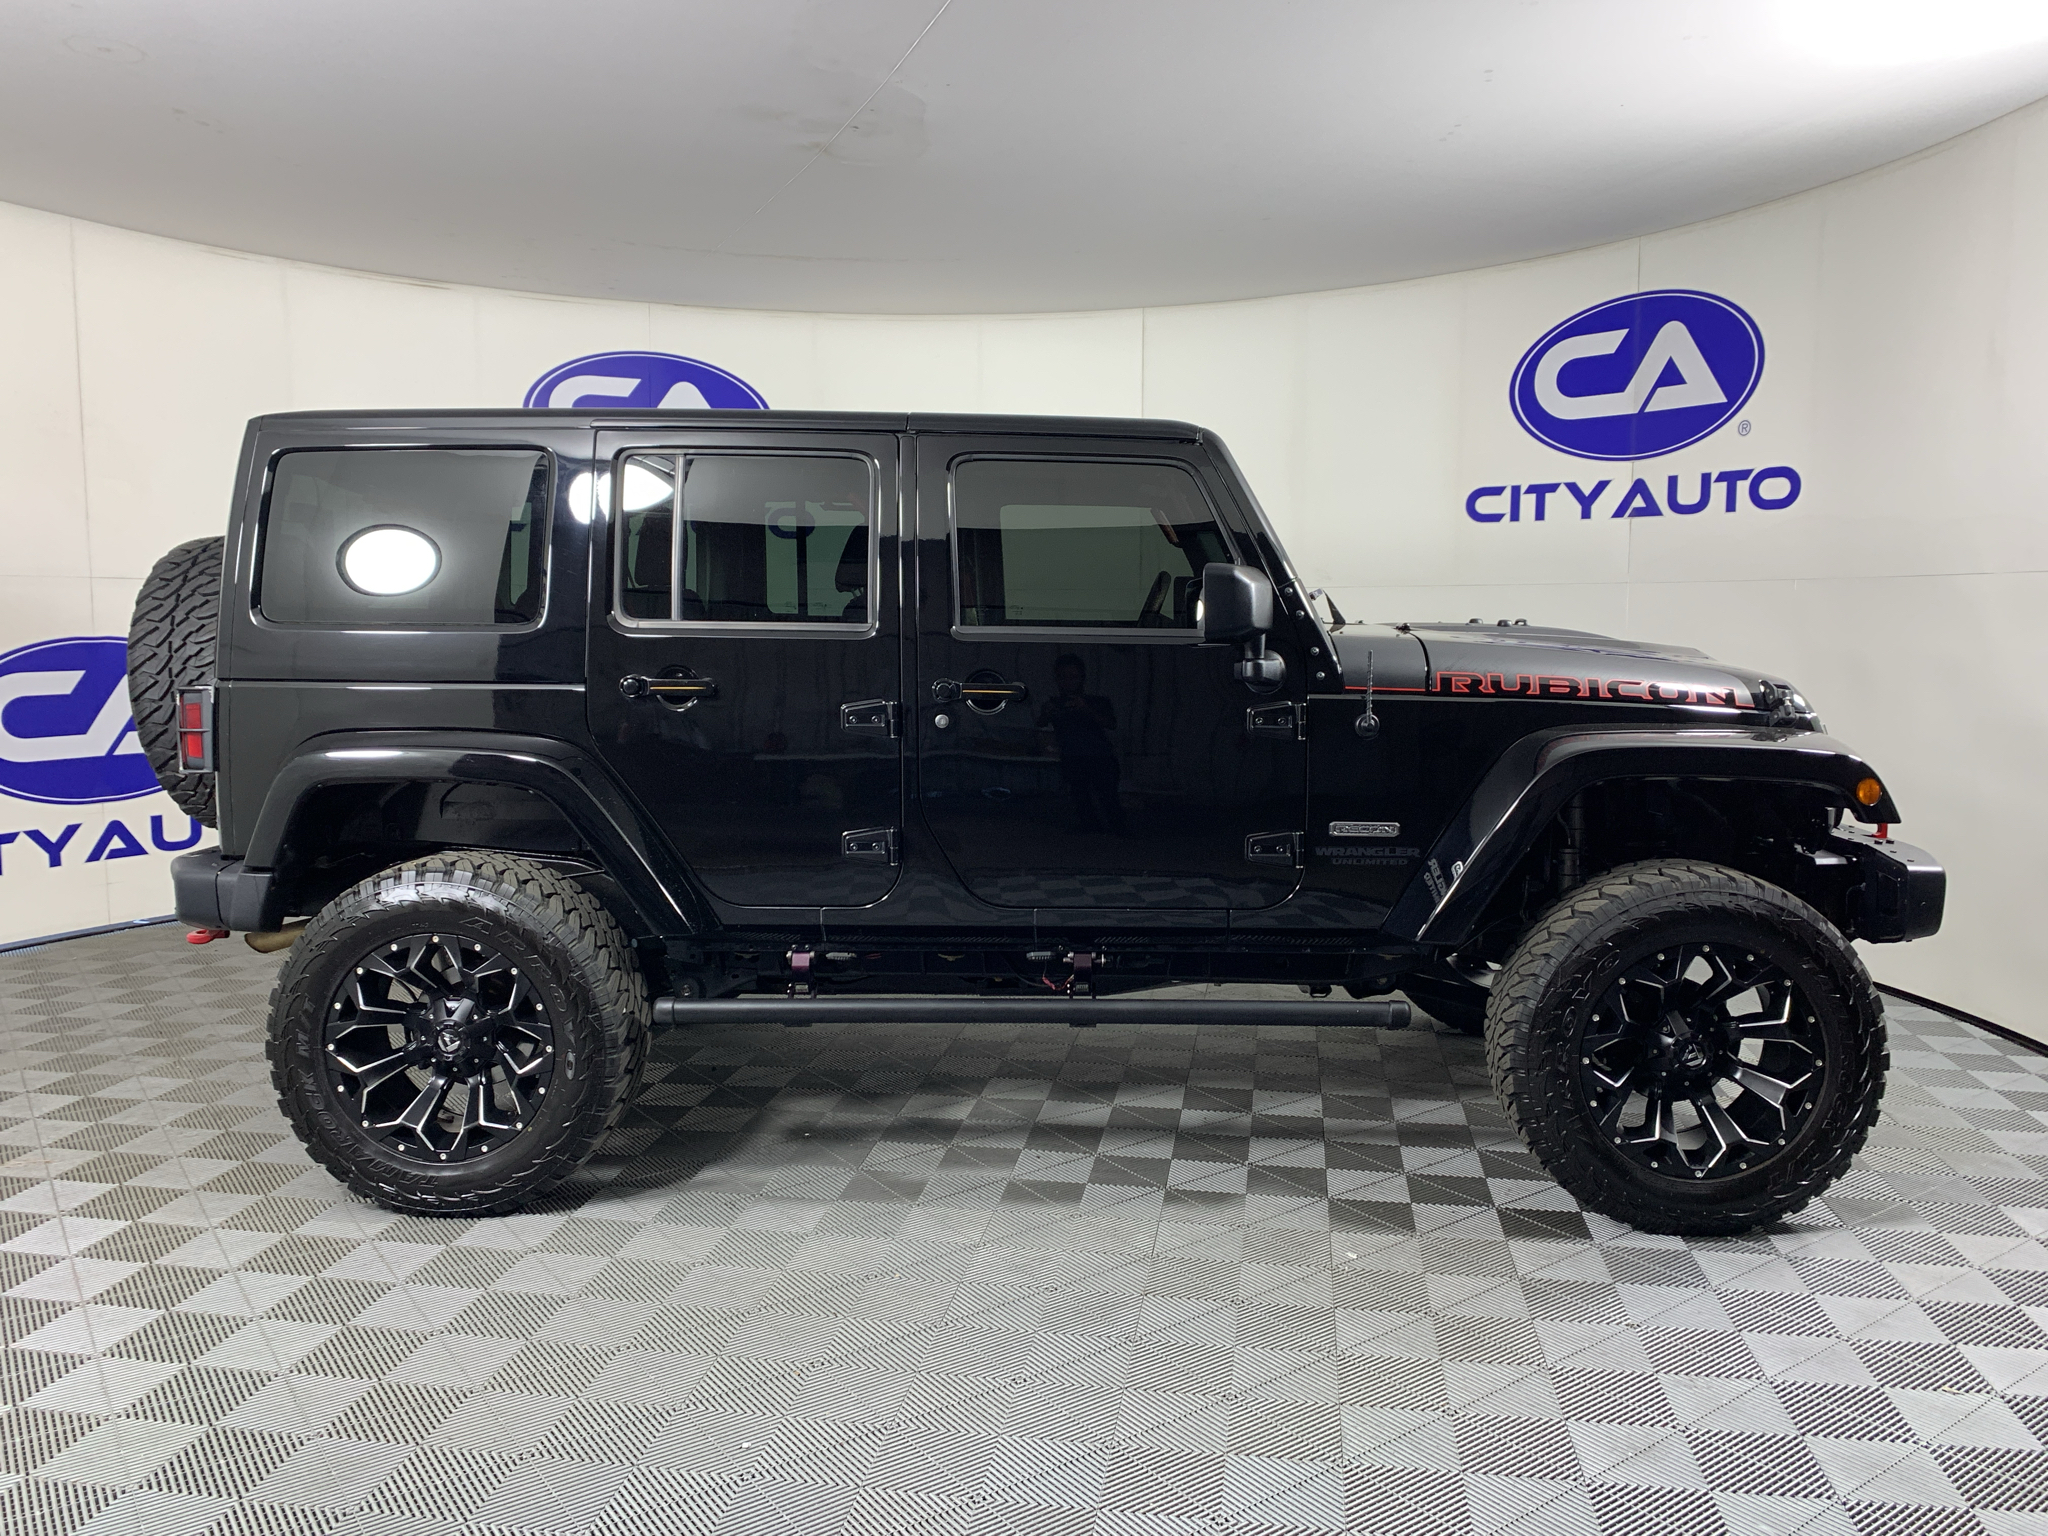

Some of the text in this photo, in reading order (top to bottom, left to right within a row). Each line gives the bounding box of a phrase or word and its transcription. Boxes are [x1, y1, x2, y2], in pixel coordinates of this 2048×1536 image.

[1534, 320, 1729, 421] CA
[1465, 465, 1802, 523] CITY AUTO
[1431, 671, 1755, 708] RUBICON
[1315, 846, 1421, 857] WRANGLER
[1332, 857, 1409, 866] UNLIMITED
